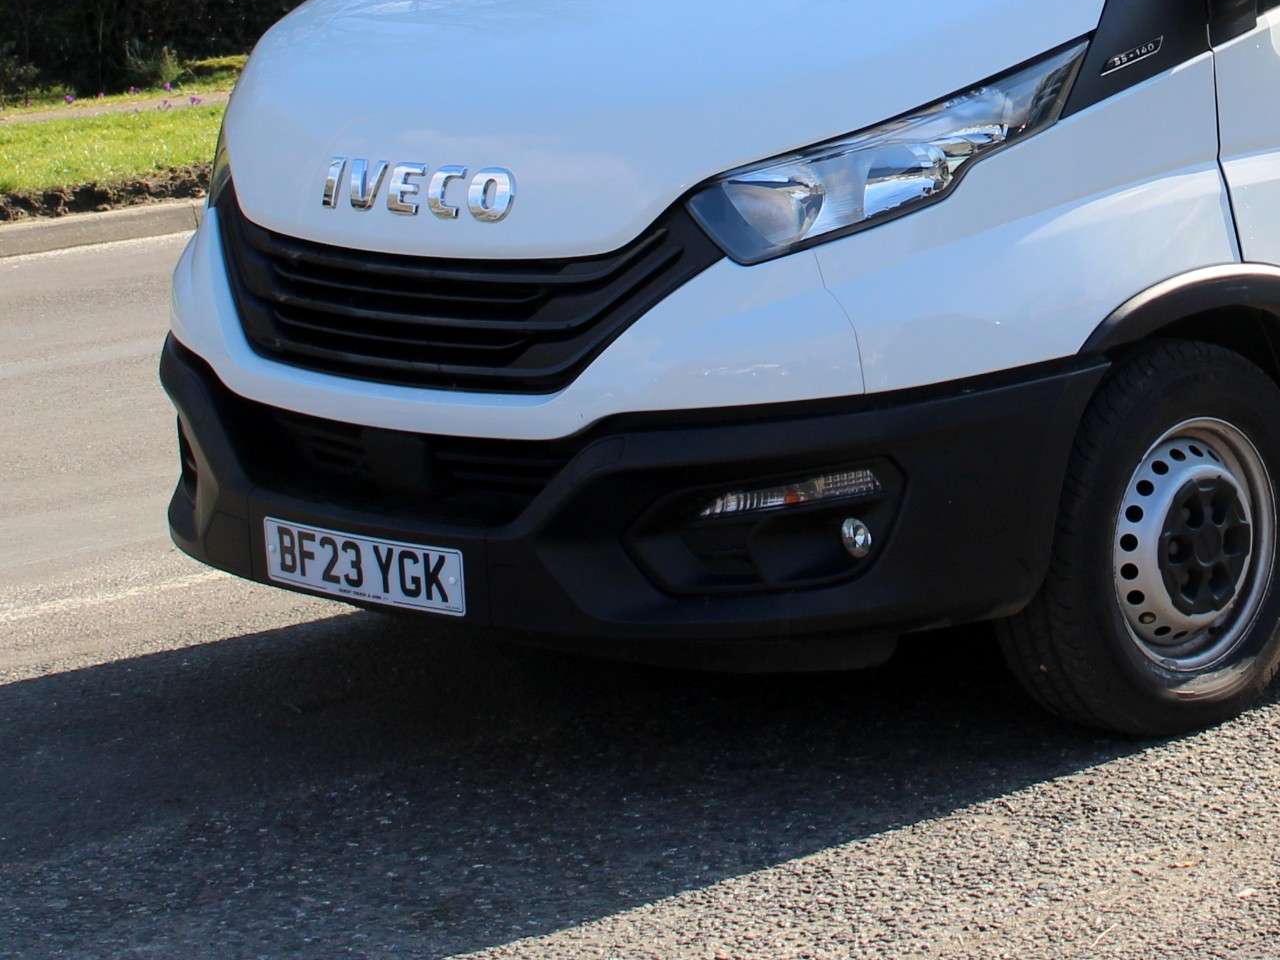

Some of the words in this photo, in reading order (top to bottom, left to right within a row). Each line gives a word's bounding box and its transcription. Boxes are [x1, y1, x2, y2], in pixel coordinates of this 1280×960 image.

[322, 156, 517, 223] IVECO
[277, 526, 363, 588] BF23
[373, 545, 448, 602] YGK
